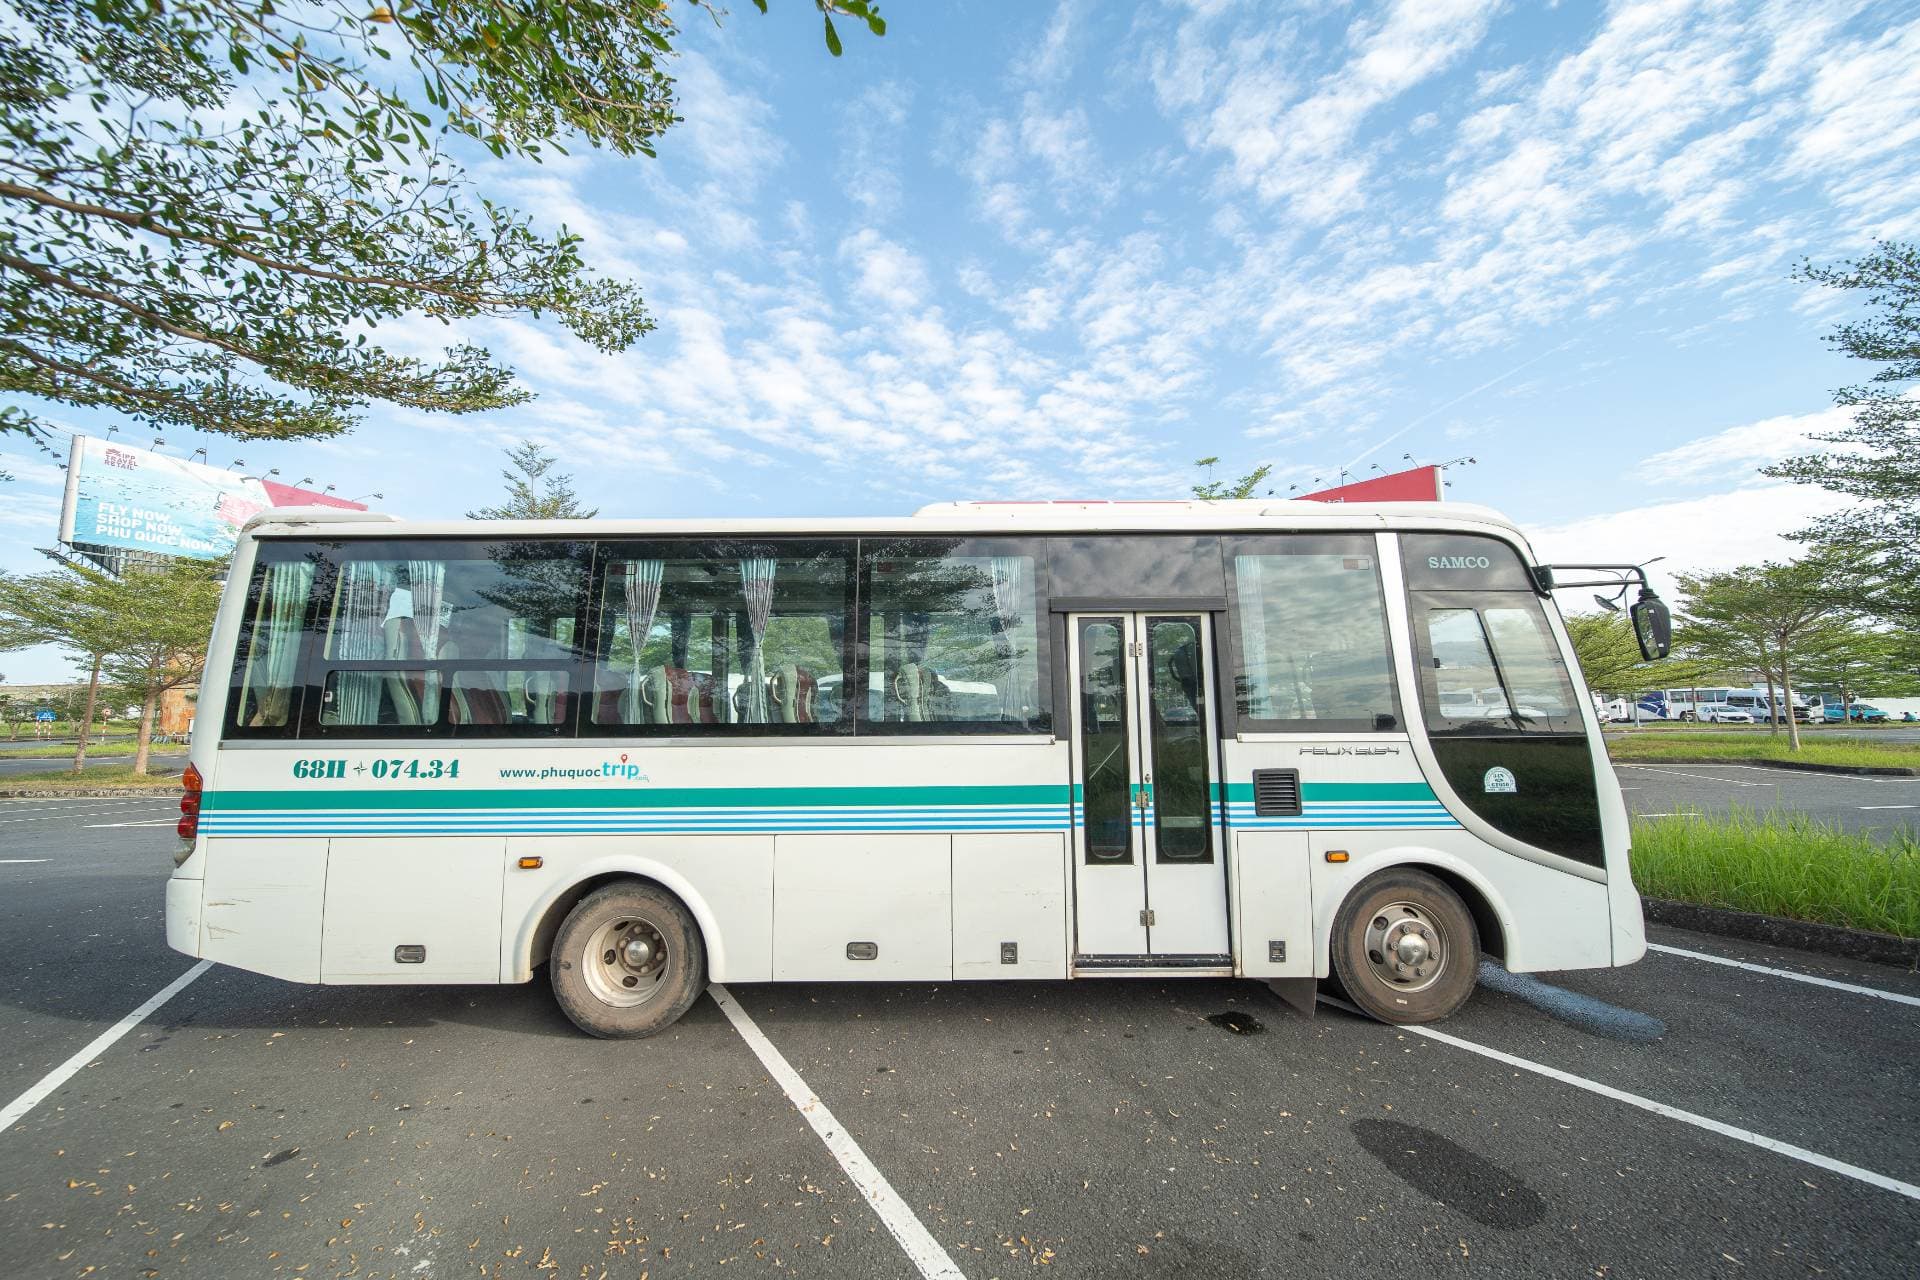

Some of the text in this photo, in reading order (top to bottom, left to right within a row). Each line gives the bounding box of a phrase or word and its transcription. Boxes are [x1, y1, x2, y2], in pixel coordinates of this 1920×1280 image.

[104, 459, 134, 471] RETAIL
[105, 454, 138, 467] TRAVEL
[98, 502, 127, 516] FLY
[97, 513, 143, 529] SHOP
[1428, 556, 1490, 569] SAMCO
[293, 759, 460, 779] 68H 074.34
